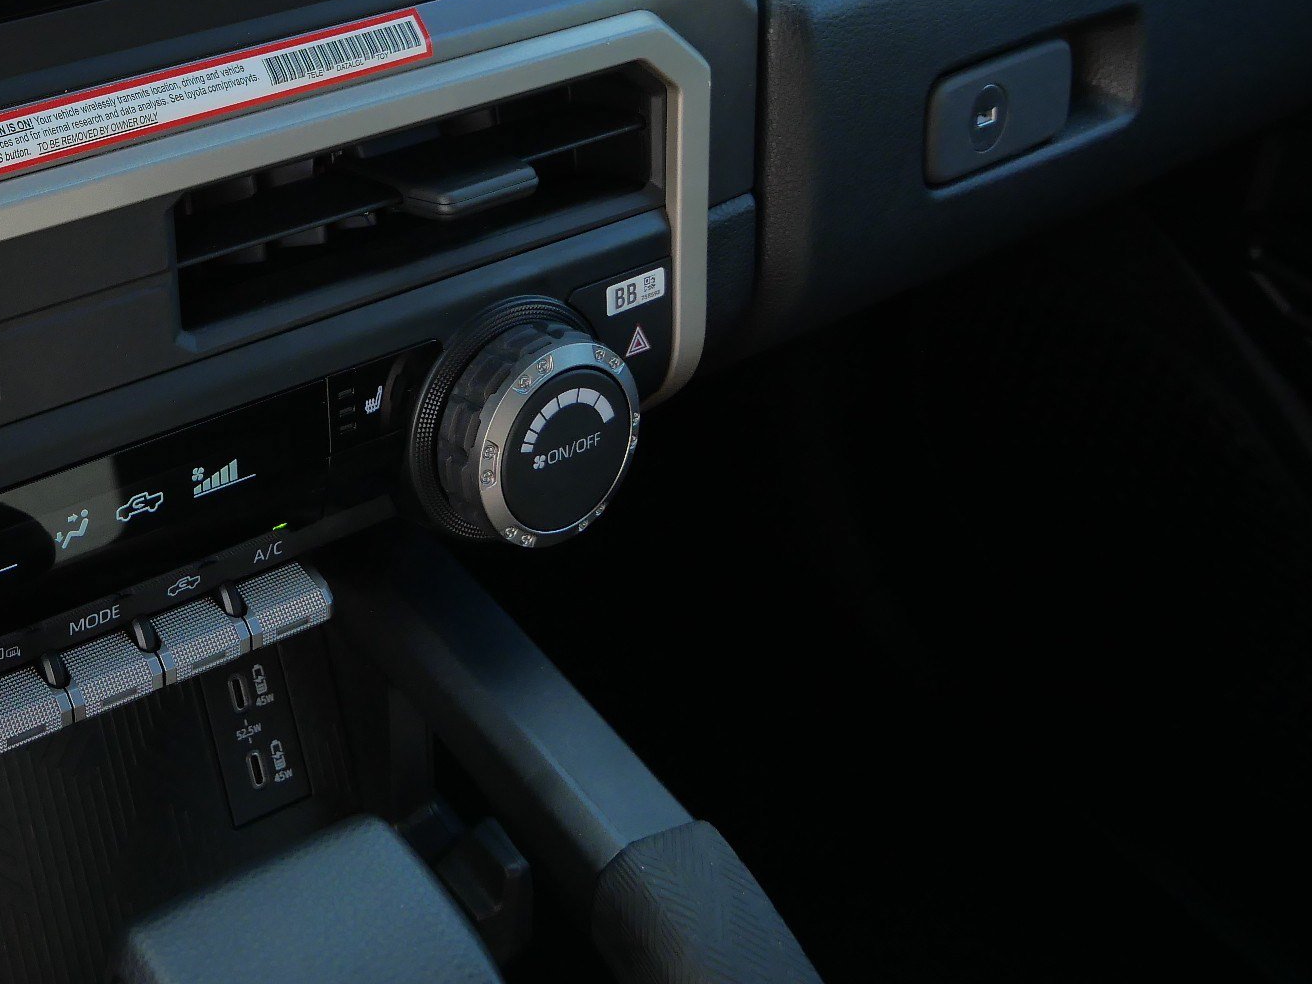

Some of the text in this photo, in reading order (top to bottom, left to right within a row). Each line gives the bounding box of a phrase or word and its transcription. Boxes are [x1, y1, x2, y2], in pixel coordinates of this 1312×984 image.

[6, 123, 16, 133] IS
[16, 118, 33, 130] ON!
[34, 114, 52, 126] Your
[53, 107, 80, 121] vehicle
[80, 97, 116, 113] wirelessly
[117, 88, 150, 104] transmits
[182, 74, 205, 88] driving
[206, 70, 219, 80] and
[220, 64, 245, 77] vehicle
[15, 134, 29, 144] and
[30, 128, 41, 140] for
[42, 122, 70, 137] internal
[72, 113, 105, 129] research
[105, 109, 119, 121] and
[121, 105, 136, 117] data
[168, 93, 184, 104] See
[5, 147, 31, 162] button.
[37, 141, 49, 153] TO
[49, 137, 60, 149] BE
[61, 127, 99, 146] REMOVED
[99, 123, 110, 135] BY
[110, 117, 139, 133] OWNER
[139, 112, 158, 126] ONLY
[615, 282, 637, 310] BB
[547, 432, 601, 465] ON/OFF
[253, 540, 283, 565] A/C
[69, 605, 121, 636] MODE
[255, 693, 275, 707] 45W
[274, 768, 293, 783] 45W
